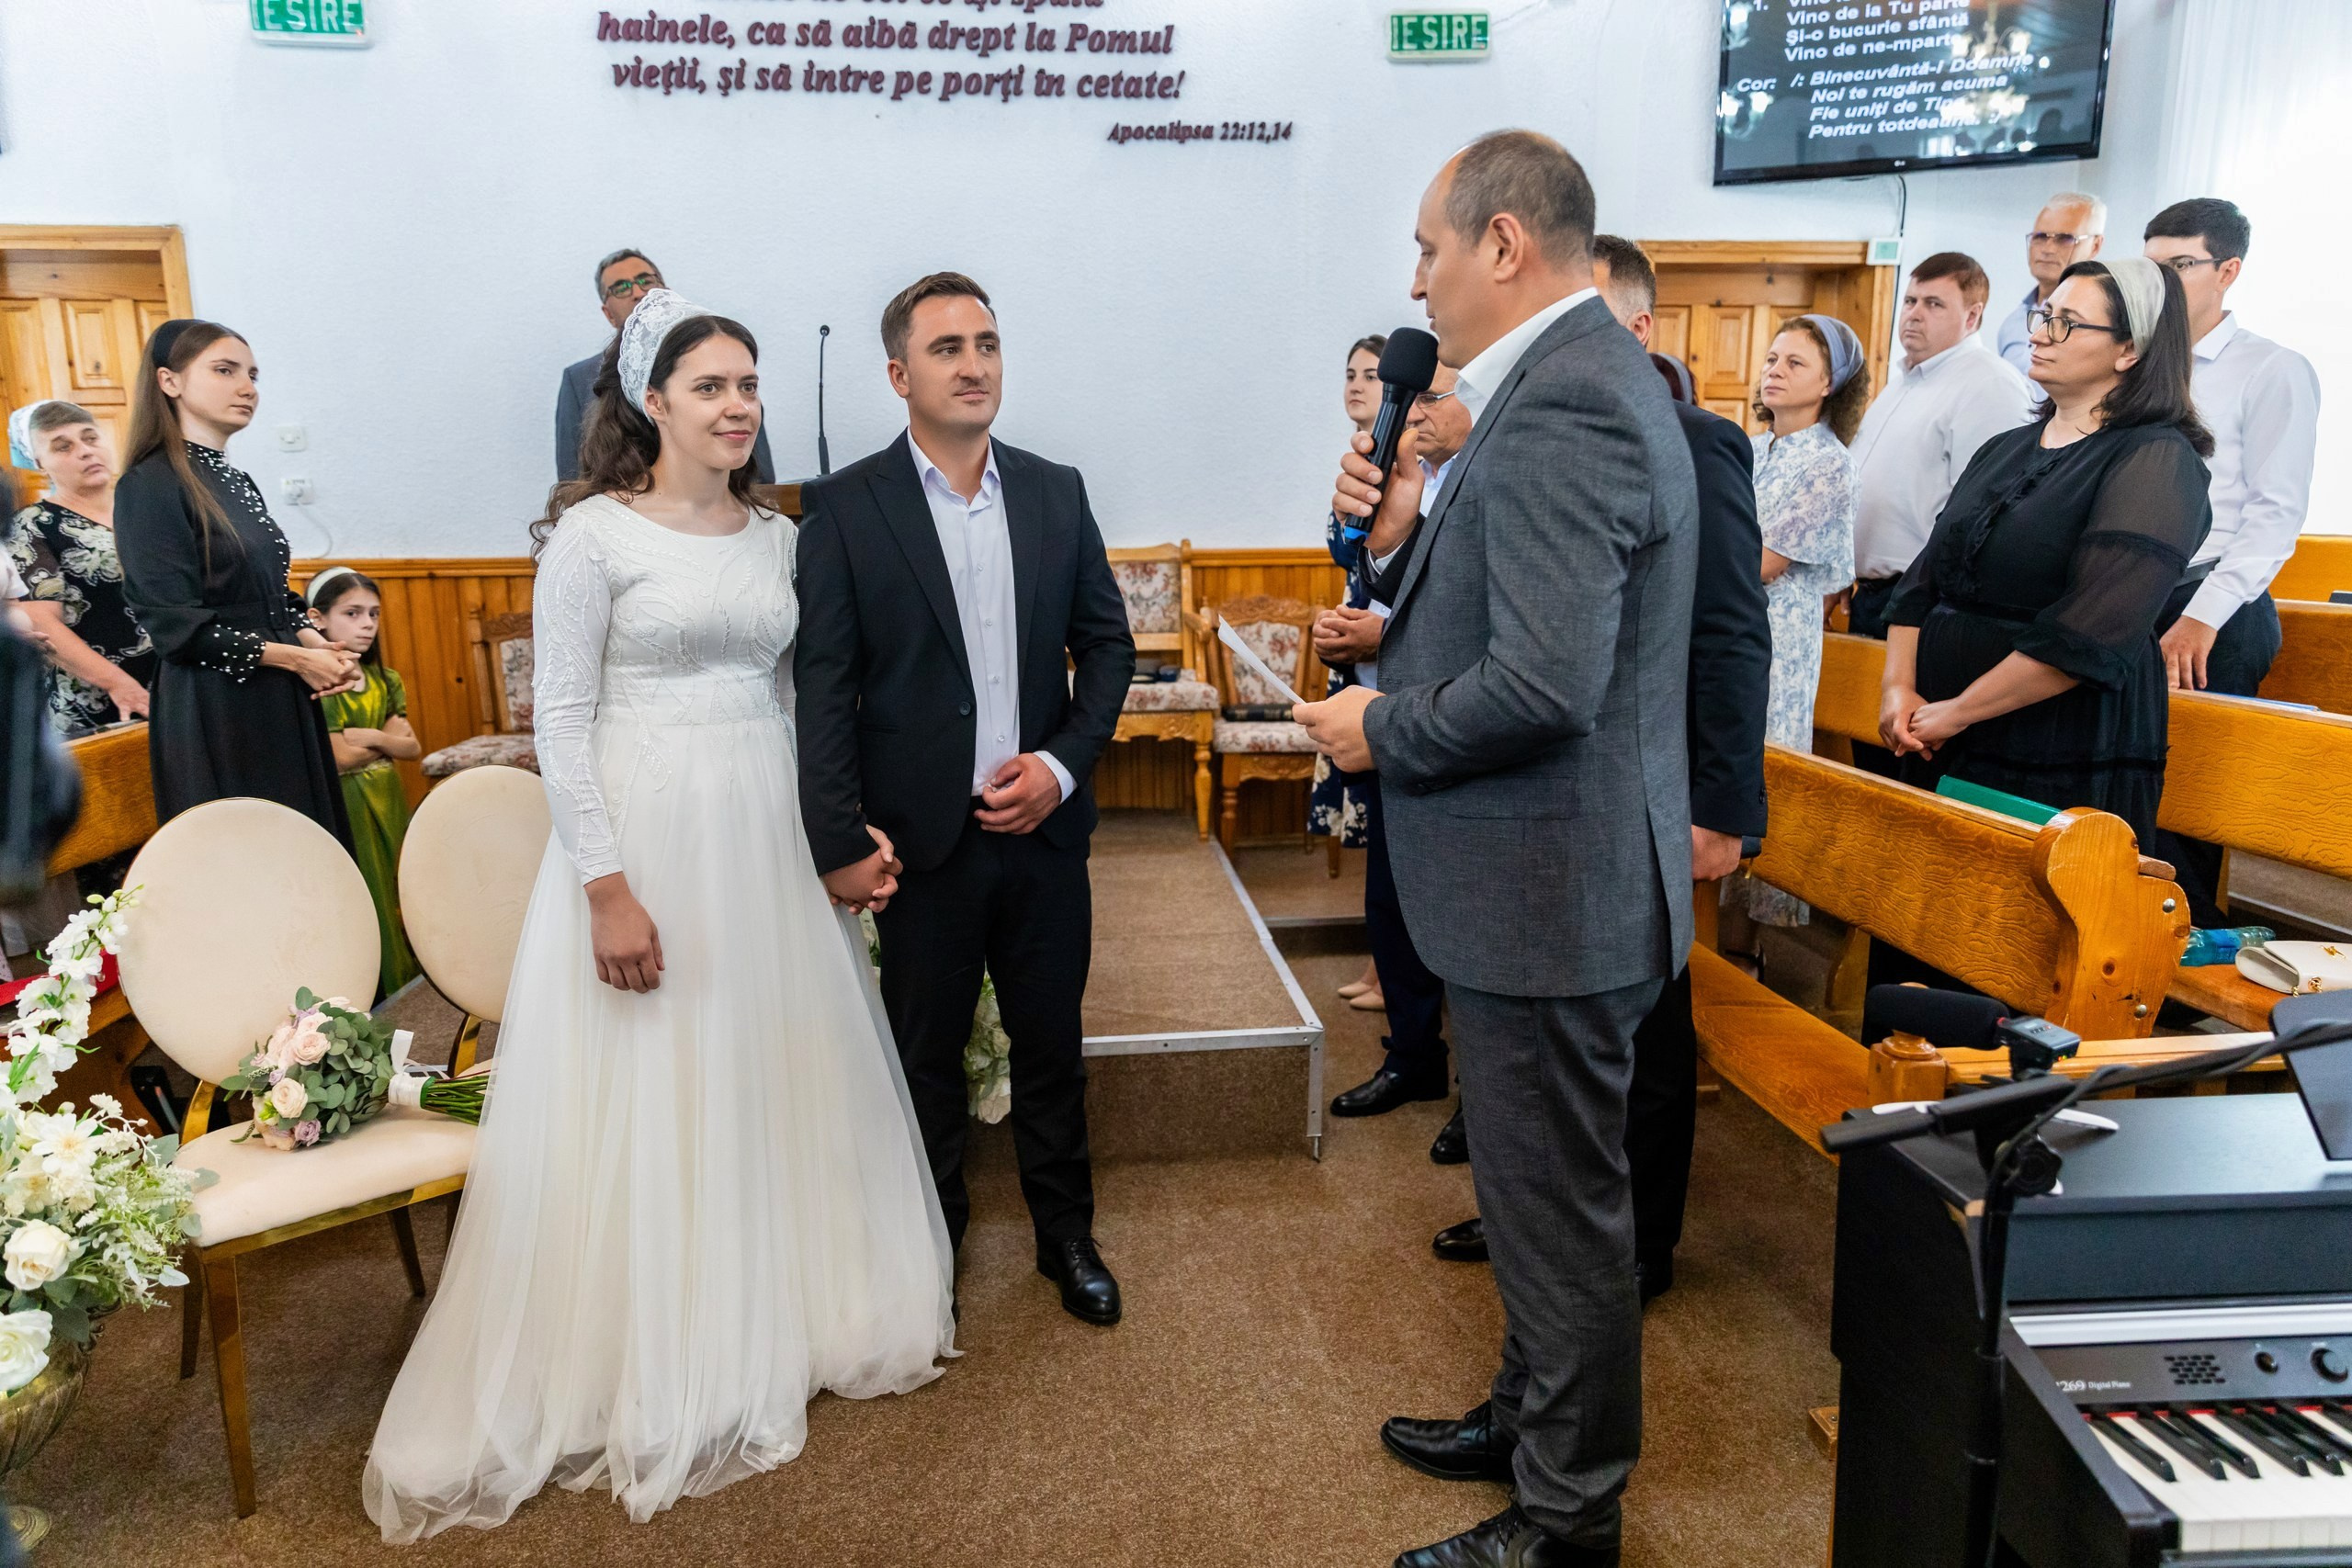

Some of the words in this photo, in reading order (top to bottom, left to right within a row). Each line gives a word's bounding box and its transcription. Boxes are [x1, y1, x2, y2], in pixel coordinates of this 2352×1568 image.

[1786, 10, 1831, 26] Vino
[1835, 6, 1860, 21] de
[1888, 0, 1913, 15] Tu
[1919, 0, 1970, 16] parte
[597, 10, 735, 49] hainele,
[747, 21, 786, 45] ca
[796, 19, 832, 47] să
[842, 16, 918, 49] aibă
[928, 20, 1017, 57] drept
[1025, 22, 1057, 51] la
[1064, 23, 1175, 54] Pomul
[1828, 19, 1902, 39] bucurie
[1784, 47, 1828, 62] Vino
[1832, 42, 1857, 57] de
[755, 63, 792, 91] să
[803, 60, 885, 95] intre
[890, 71, 933, 101] pe
[1034, 68, 1066, 96] în
[1076, 70, 1186, 98] cetate!
[1736, 78, 1777, 92] Cor:
[1949, 54, 2034, 73] Doamne
[1810, 86, 1846, 104] Noi
[1849, 85, 1868, 100] te
[1940, 74, 2008, 92] acuma
[1810, 106, 1839, 121] Fie
[1893, 99, 1918, 114] de
[1107, 119, 1215, 144] Apocalipsa
[1220, 121, 1293, 144] 22:12,14
[1808, 122, 1872, 139] Pentru
